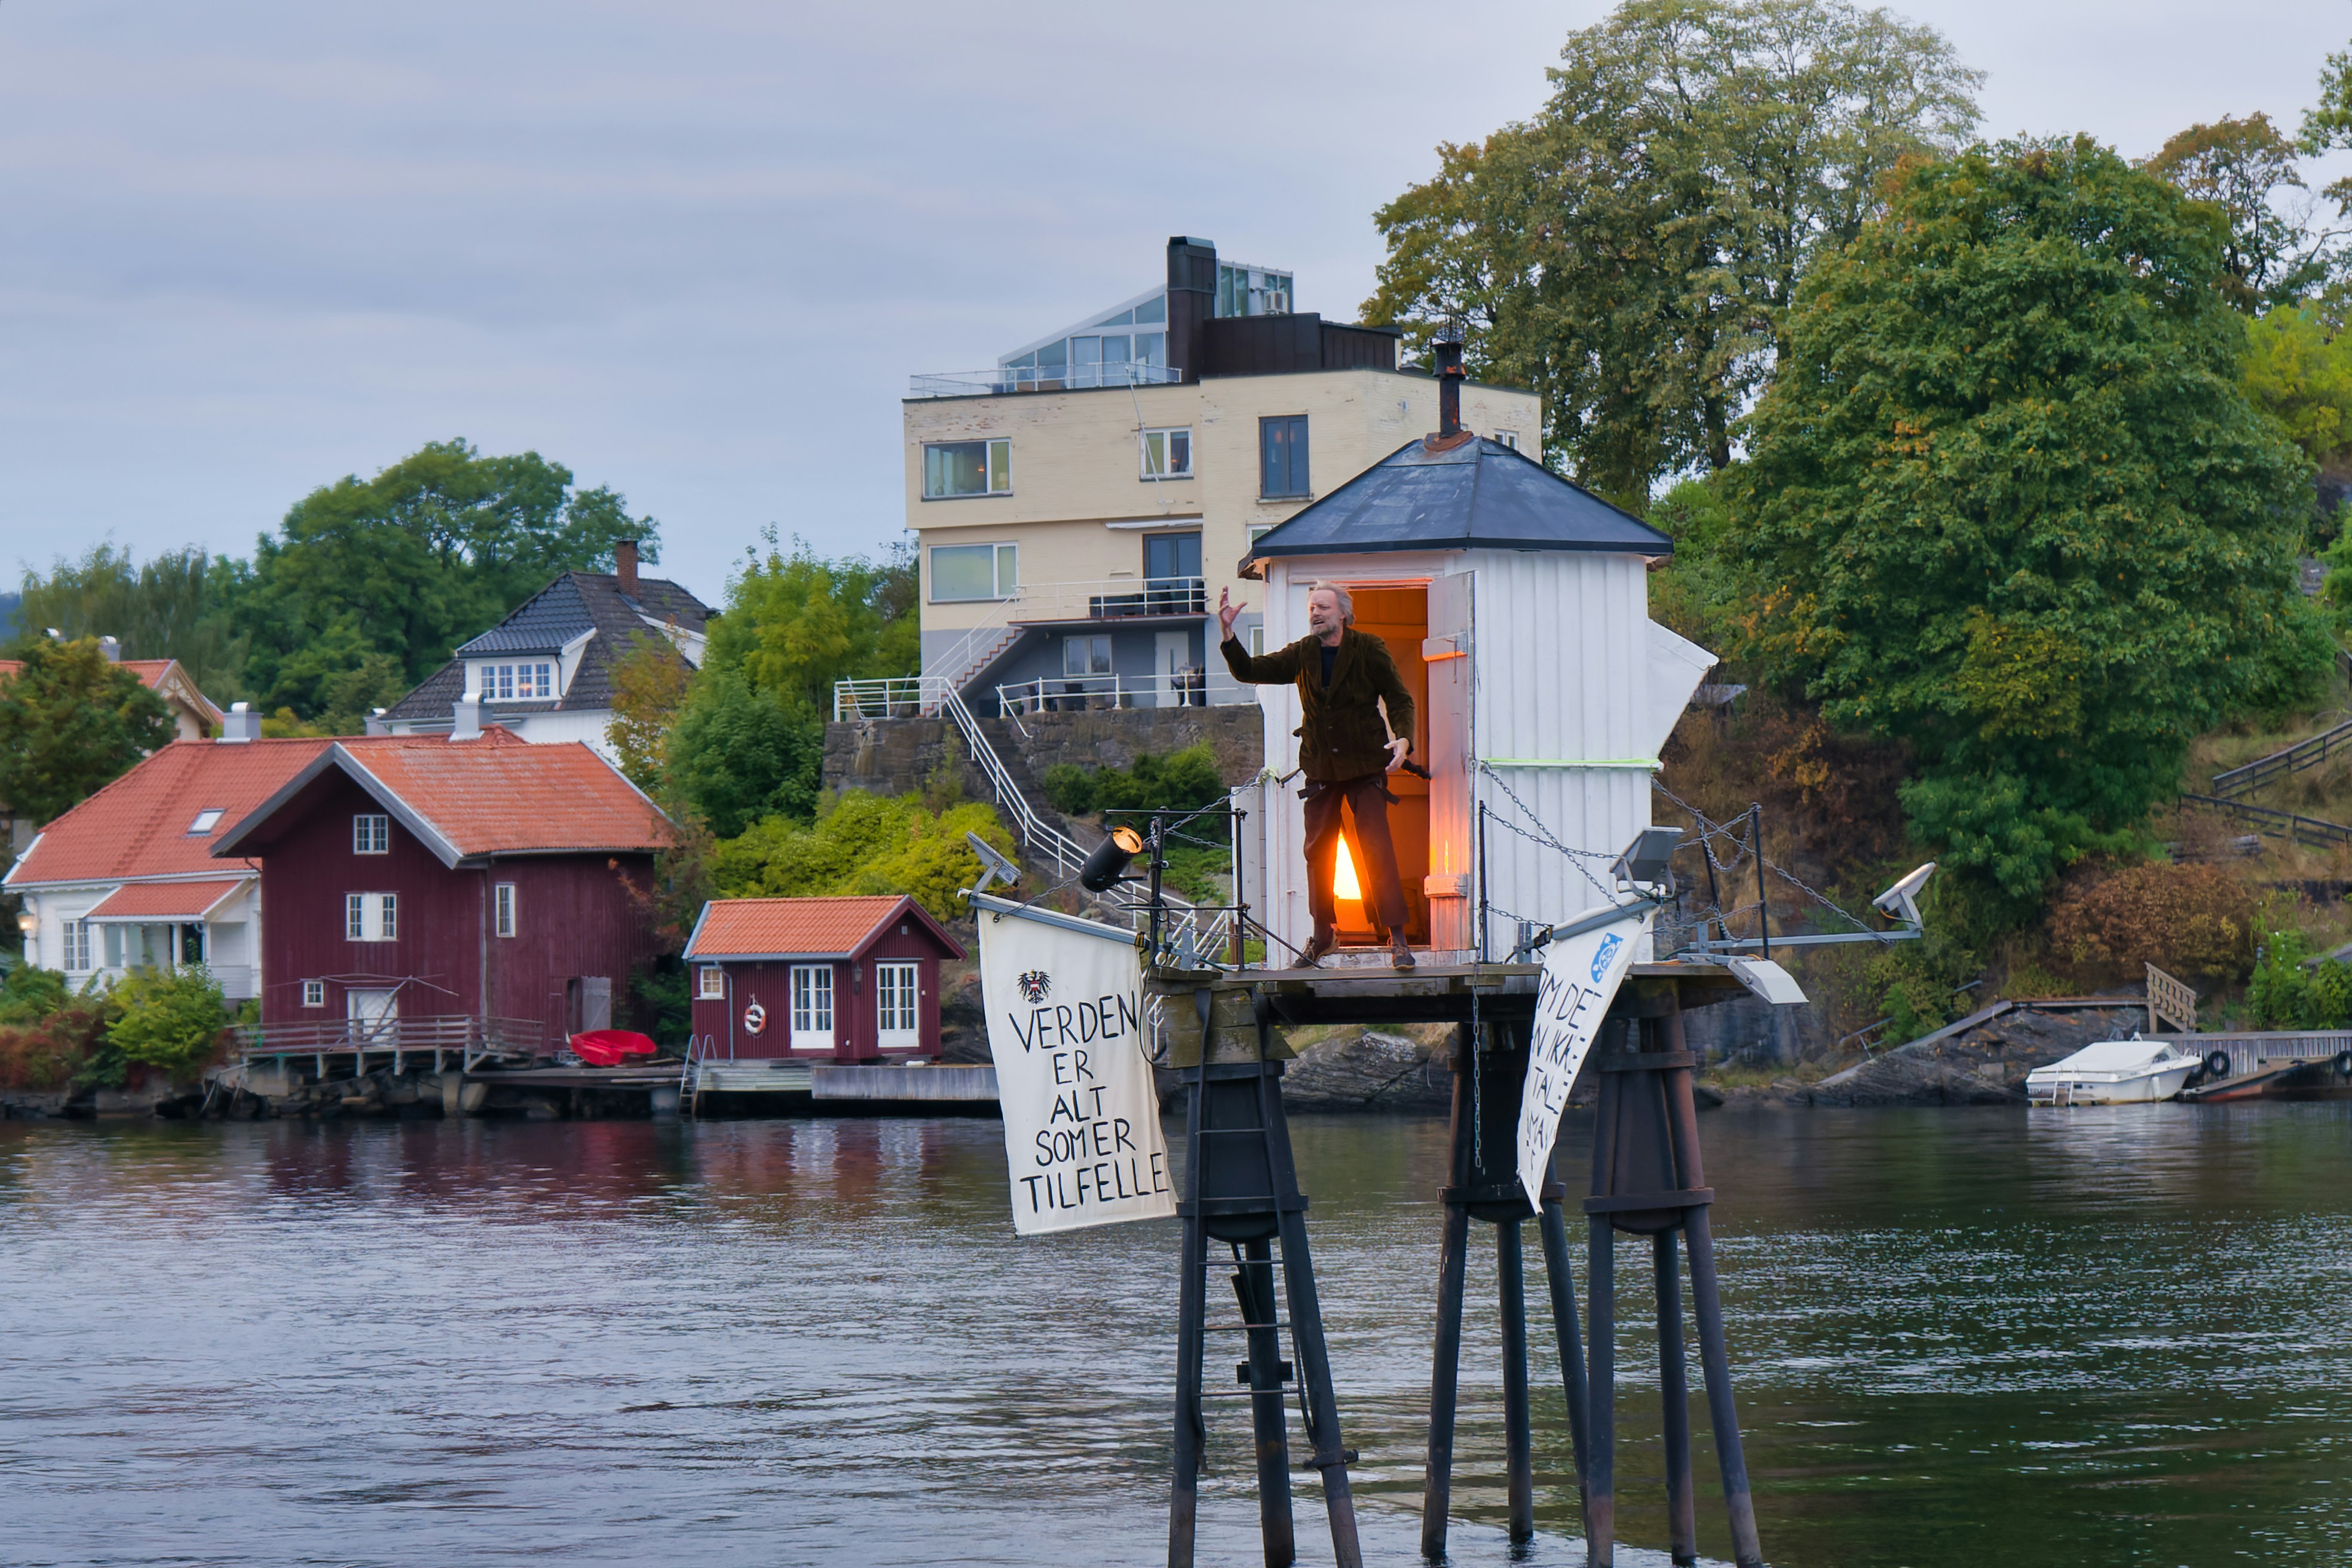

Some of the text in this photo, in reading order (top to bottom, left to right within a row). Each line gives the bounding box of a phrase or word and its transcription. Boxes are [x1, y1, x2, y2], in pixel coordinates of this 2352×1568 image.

[1009, 991, 1137, 1053] VERDEN
[1054, 1050, 1094, 1085] ER
[1051, 1086, 1107, 1124] ALT
[1019, 1153, 1169, 1214] TILFELLE
